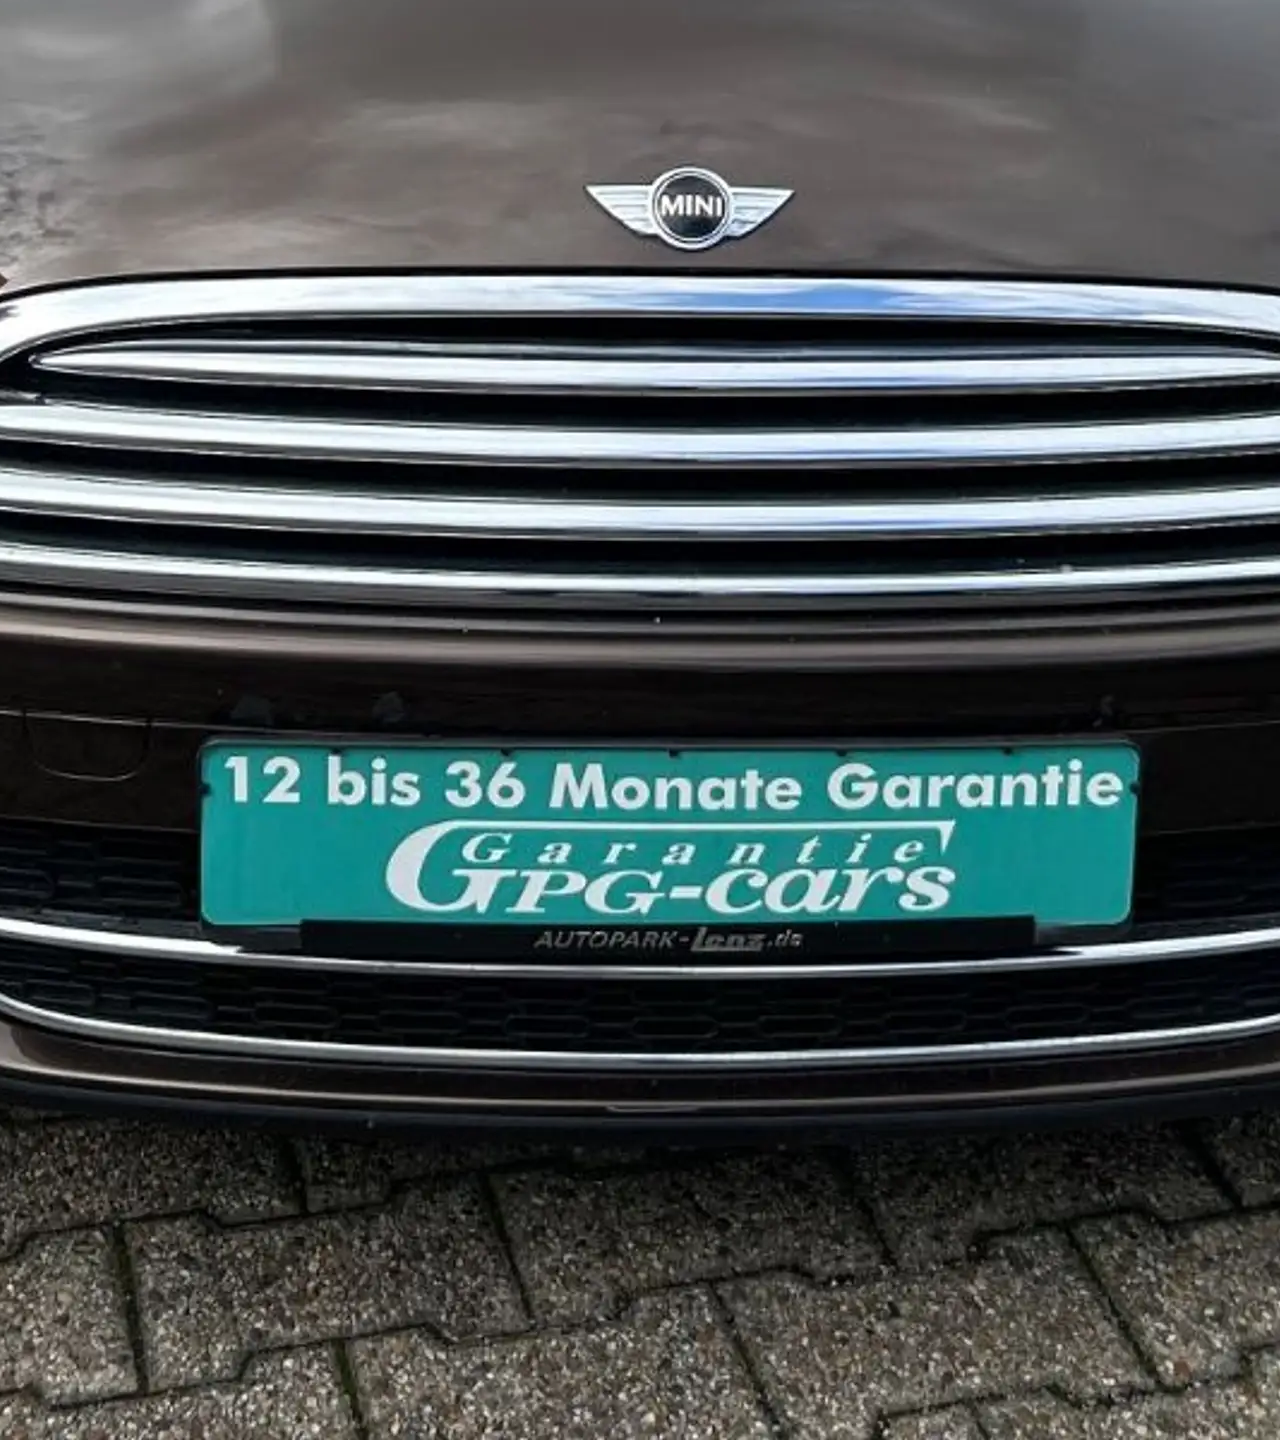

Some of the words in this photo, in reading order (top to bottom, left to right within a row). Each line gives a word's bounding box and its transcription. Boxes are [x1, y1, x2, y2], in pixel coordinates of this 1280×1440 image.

[660, 194, 723, 218] MINI
[224, 755, 302, 804] 12
[327, 754, 421, 806] bis
[445, 760, 526, 809] 36
[549, 762, 803, 811] Monate
[827, 758, 1124, 810] Garantie
[462, 831, 926, 866] Garantie
